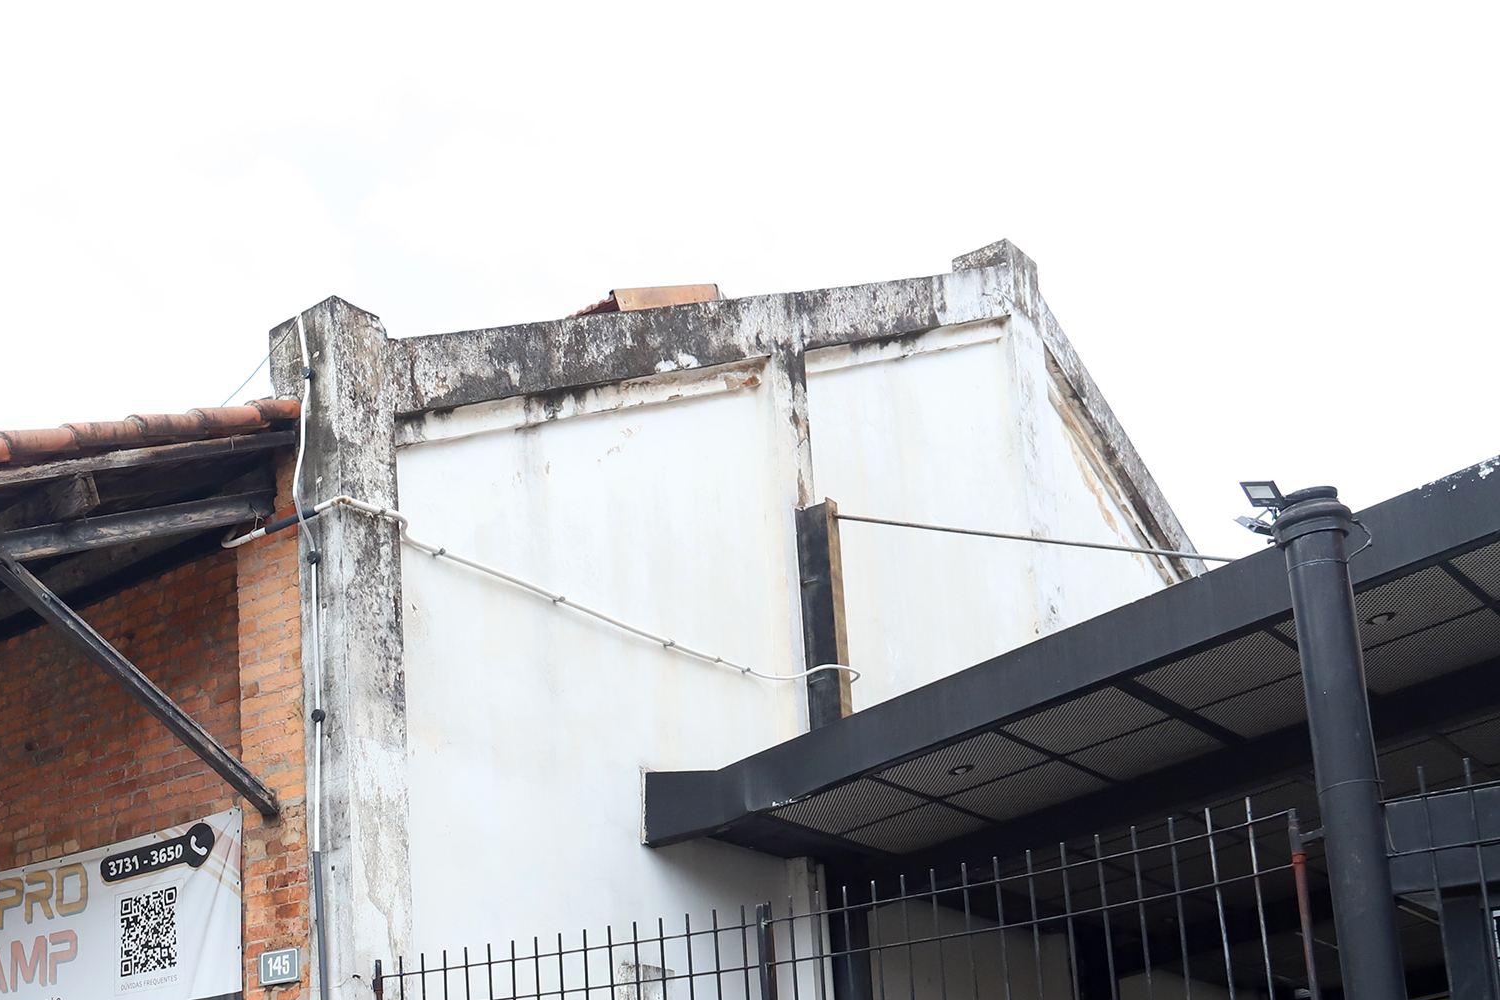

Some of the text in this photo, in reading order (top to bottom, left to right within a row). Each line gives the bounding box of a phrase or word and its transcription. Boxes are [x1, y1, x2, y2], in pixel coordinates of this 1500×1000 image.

[108, 855, 139, 876] 3731
[150, 844, 183, 866] 3650
[268, 954, 290, 977] 145
[120, 974, 177, 991] DÚVIDAS FREQUENTES
